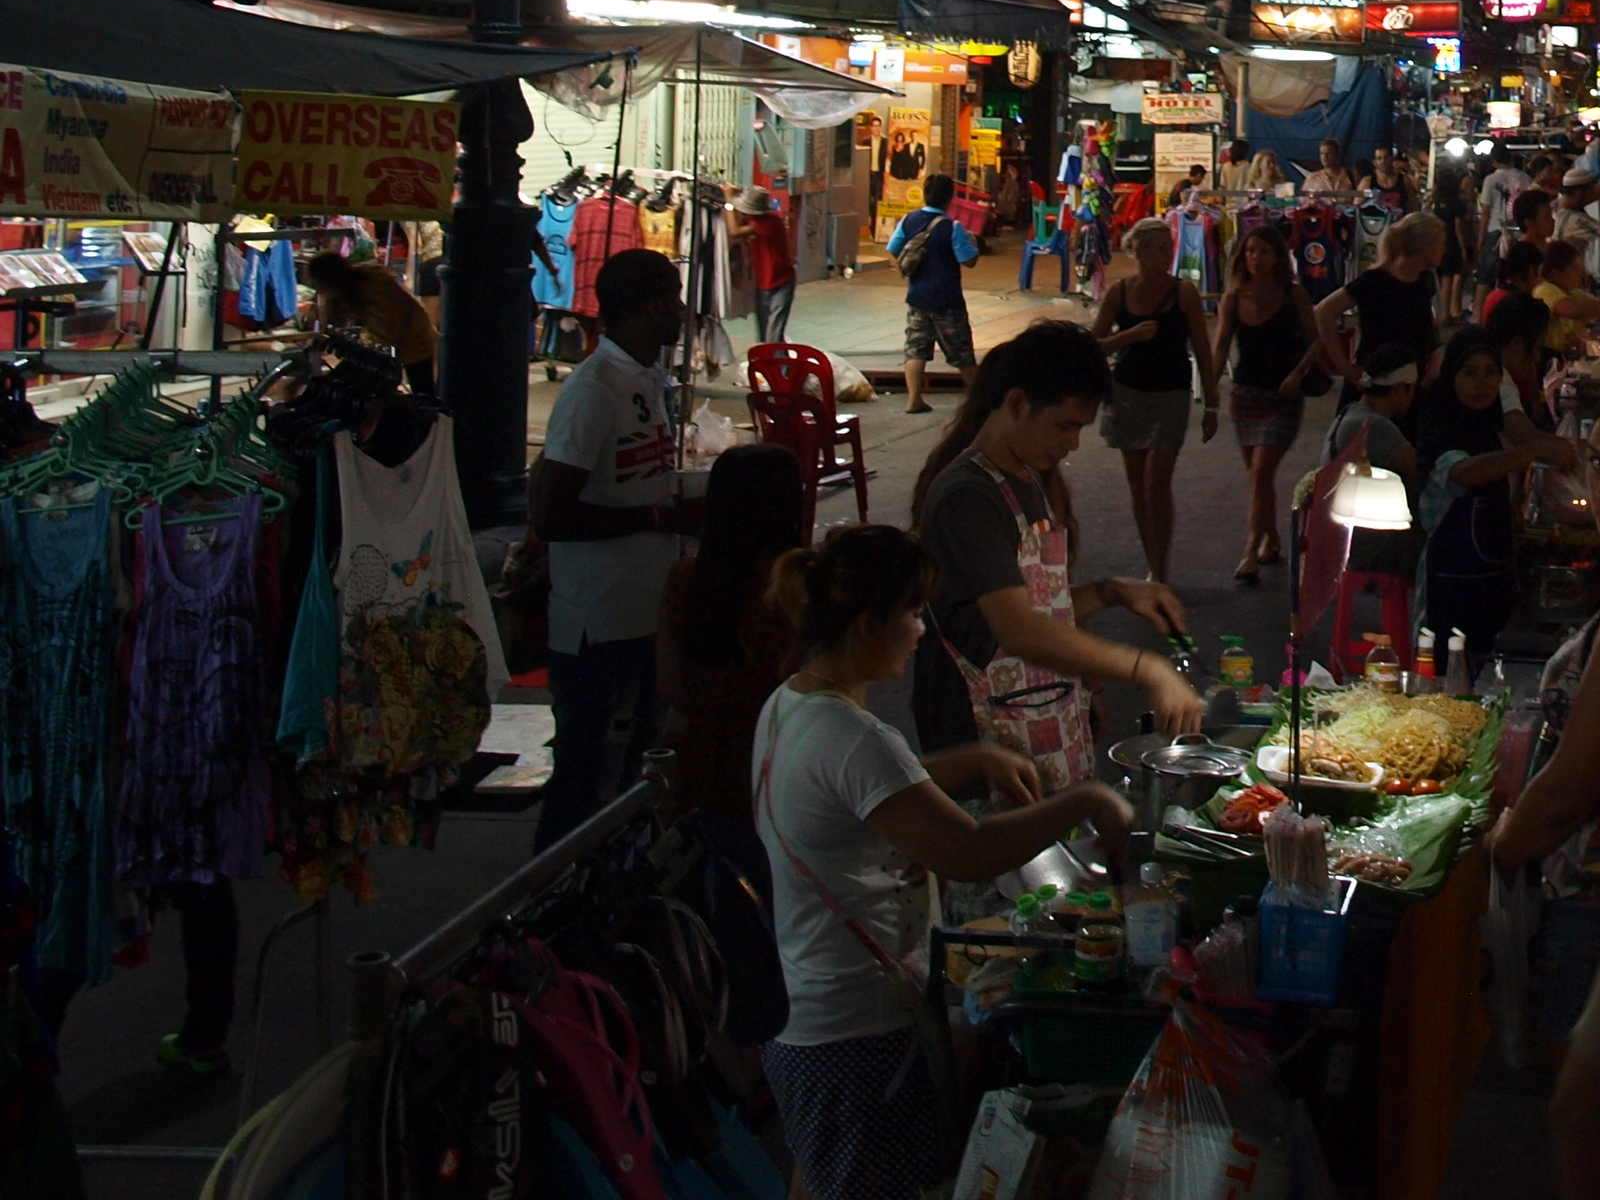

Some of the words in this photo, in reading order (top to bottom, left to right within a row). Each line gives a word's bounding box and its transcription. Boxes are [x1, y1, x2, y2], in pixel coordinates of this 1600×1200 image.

[246, 101, 459, 152] OVERSEAS
[44, 146, 81, 175] India
[42, 183, 101, 212] Vietnam
[243, 160, 351, 207] CALL
[632, 392, 651, 424] 3
